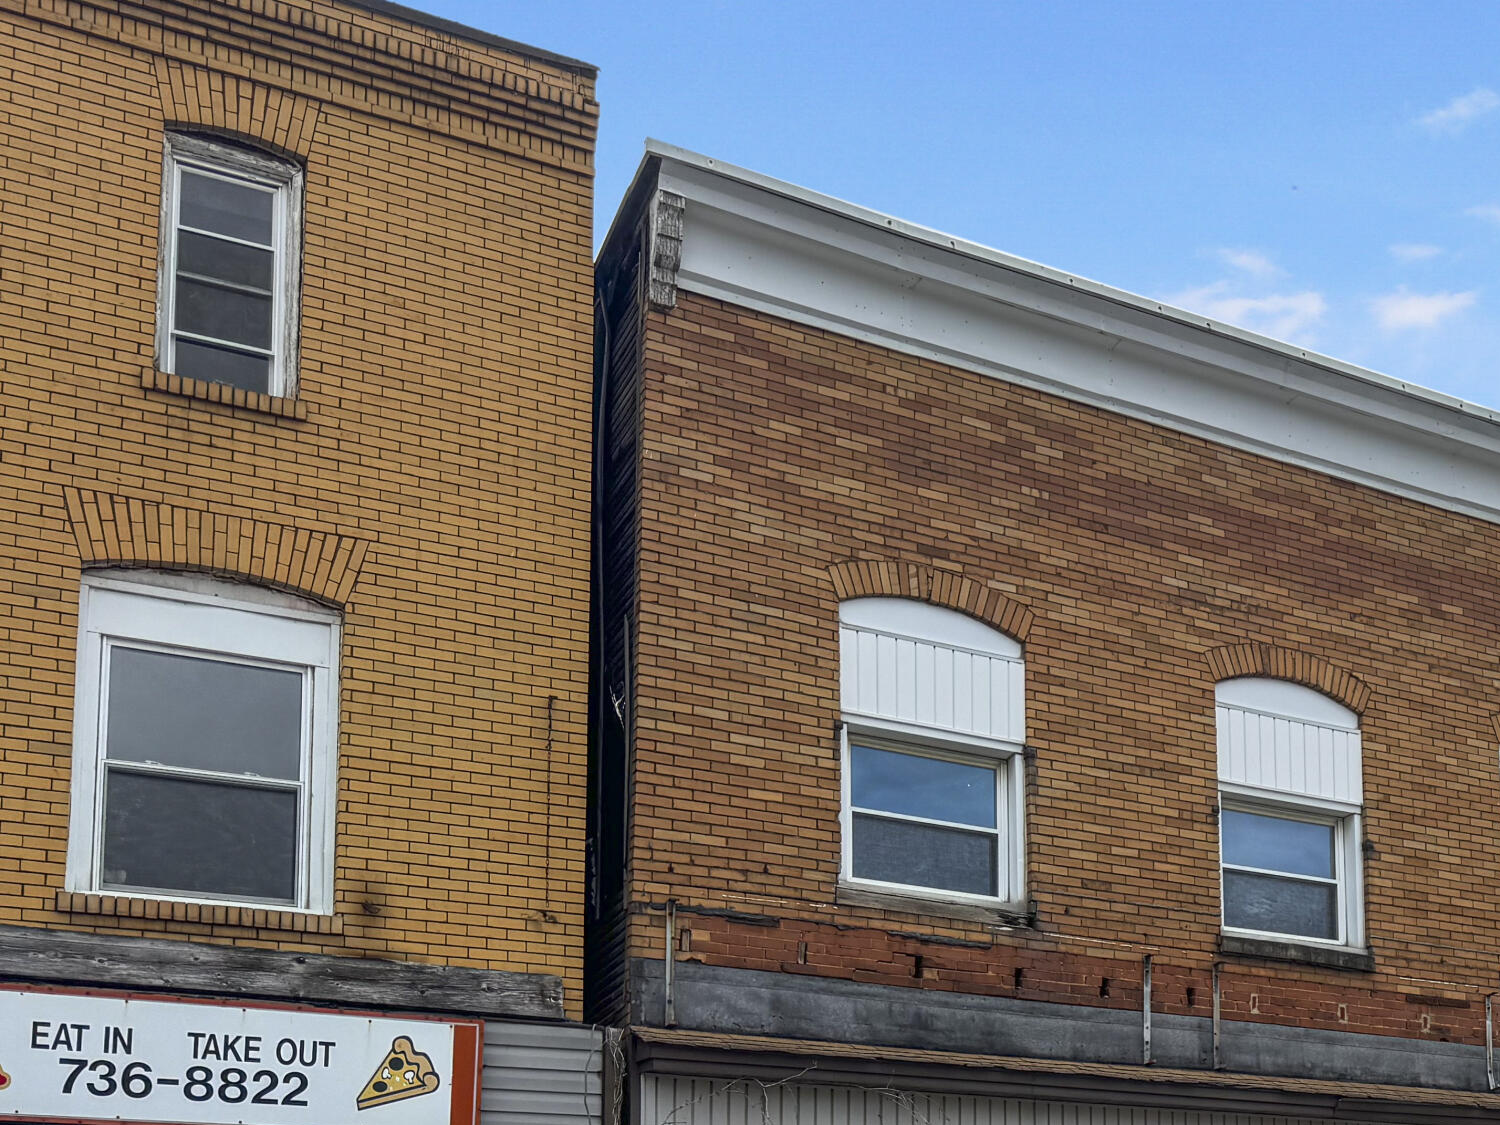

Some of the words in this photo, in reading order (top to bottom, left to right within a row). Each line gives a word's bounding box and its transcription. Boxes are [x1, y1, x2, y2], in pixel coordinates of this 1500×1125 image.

[30, 1021, 90, 1051] EAT
[103, 1026, 133, 1055] IN
[187, 1032, 262, 1063] TAKE
[275, 1037, 336, 1068] OUT
[58, 1057, 309, 1107] 736-8822
